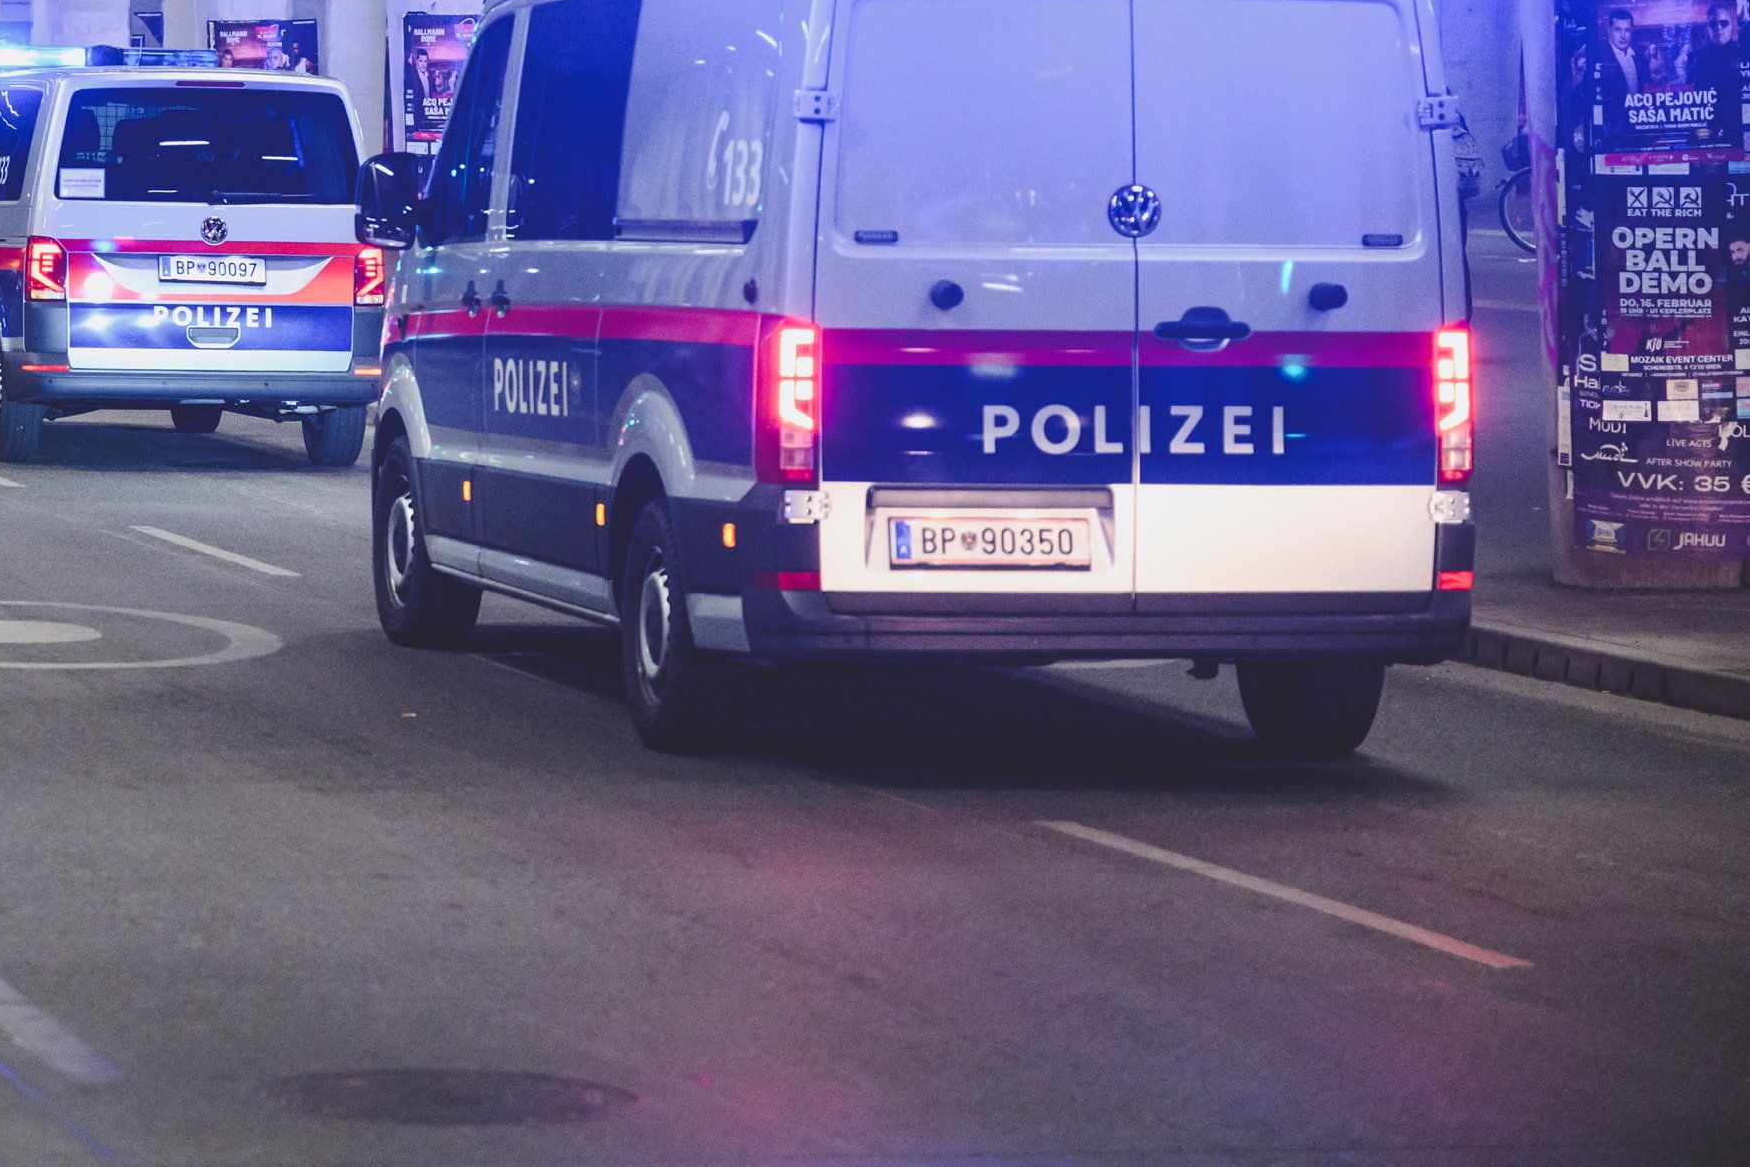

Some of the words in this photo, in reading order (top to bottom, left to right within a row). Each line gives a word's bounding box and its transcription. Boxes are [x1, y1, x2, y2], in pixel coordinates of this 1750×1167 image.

[413, 28, 445, 36] HALLMANN
[422, 97, 437, 107] ACO
[1624, 92, 1654, 108] ACO
[1655, 87, 1717, 107] PEJOVIĆ
[424, 105, 444, 116] SAŠA
[1628, 104, 1667, 124] SAŠA
[1670, 103, 1715, 122] MATIĆ
[723, 138, 763, 206] 133
[1627, 209, 1648, 217] EAT
[1650, 209, 1672, 217] THE
[1674, 209, 1702, 217] RICH
[1611, 227, 1719, 249] OPERN
[176, 260, 195, 276] BP
[208, 261, 258, 277] 90097
[1625, 249, 1706, 272] BALL
[1618, 272, 1713, 295] DEMO
[1619, 298, 1639, 309] DO,
[1640, 298, 1655, 307] 16.
[1657, 298, 1712, 307] FEBRUAR
[152, 305, 272, 328] POLIZEI
[1630, 355, 1664, 364] MOZAIK
[1666, 354, 1696, 363] EVENT
[1697, 354, 1733, 363] CENTER
[493, 357, 568, 417] POLIZEI
[982, 404, 1285, 455] POLIZEI
[1666, 438, 1687, 447] LIVE
[1688, 439, 1712, 448] ACTS
[1645, 457, 1673, 467] AFTER
[1674, 458, 1703, 468] SHOW
[1704, 459, 1732, 469] PARTY
[1617, 470, 1684, 491] VVK:
[1693, 475, 1731, 492] 35
[921, 527, 956, 555] BP
[981, 527, 1074, 556] 90350
